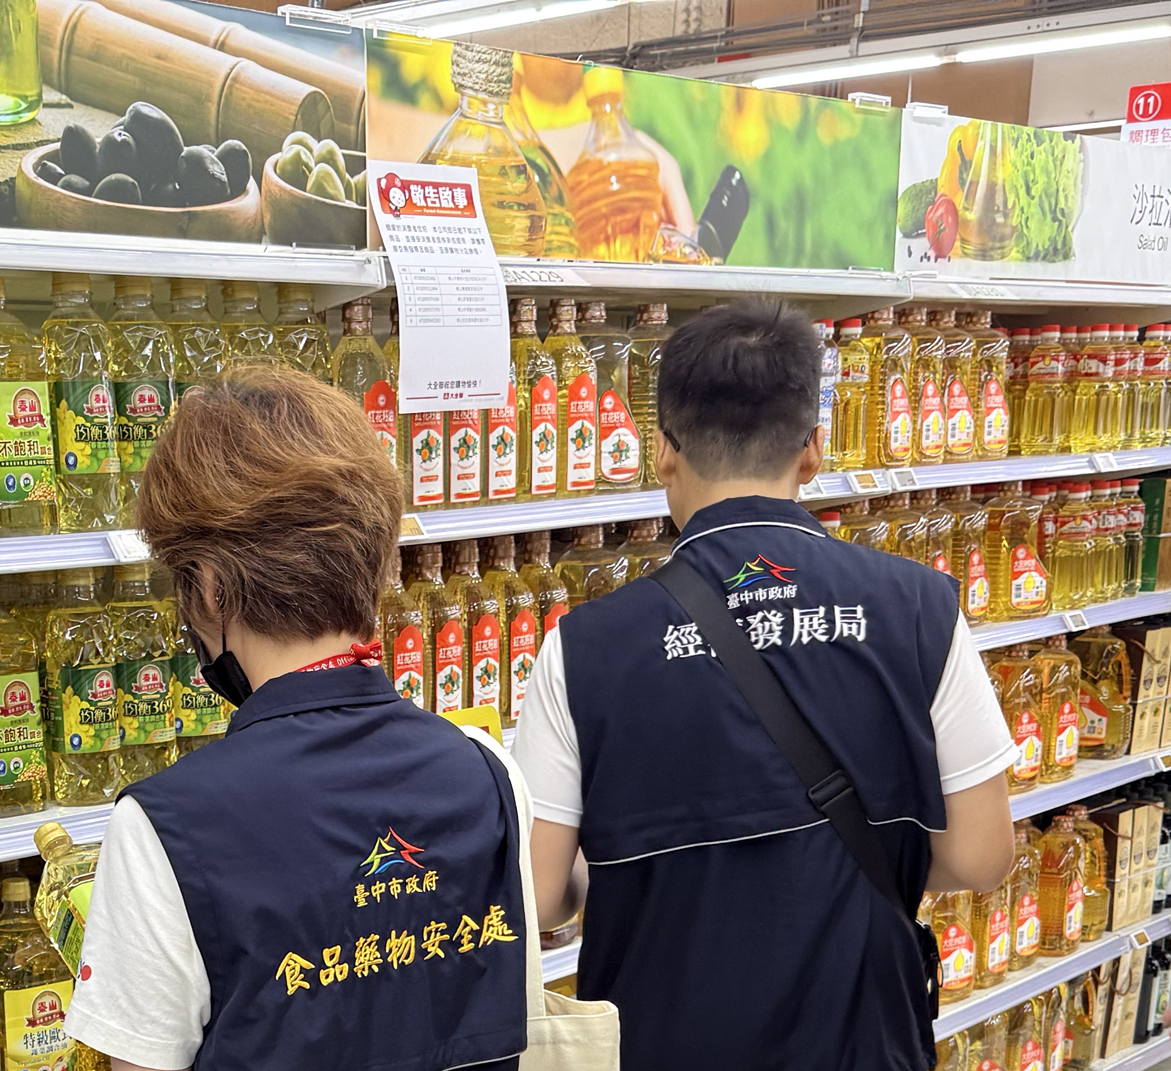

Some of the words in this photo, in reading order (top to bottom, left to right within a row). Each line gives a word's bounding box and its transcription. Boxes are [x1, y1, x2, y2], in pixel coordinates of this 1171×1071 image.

[410, 184, 468, 209] 敬告啟事
[1138, 234, 1155, 250] Salad
[1157, 236, 1168, 251] Oil
[513, 270, 564, 282] A1229
[18, 399, 38, 414] 泰山
[137, 394, 155, 403] 泰山
[726, 584, 798, 610] 臺中市政府
[663, 605, 868, 660] 經發展局
[8, 691, 27, 703] 泰山
[353, 870, 439, 908] 臺中市政府
[276, 905, 519, 995] 食品藥物安全處
